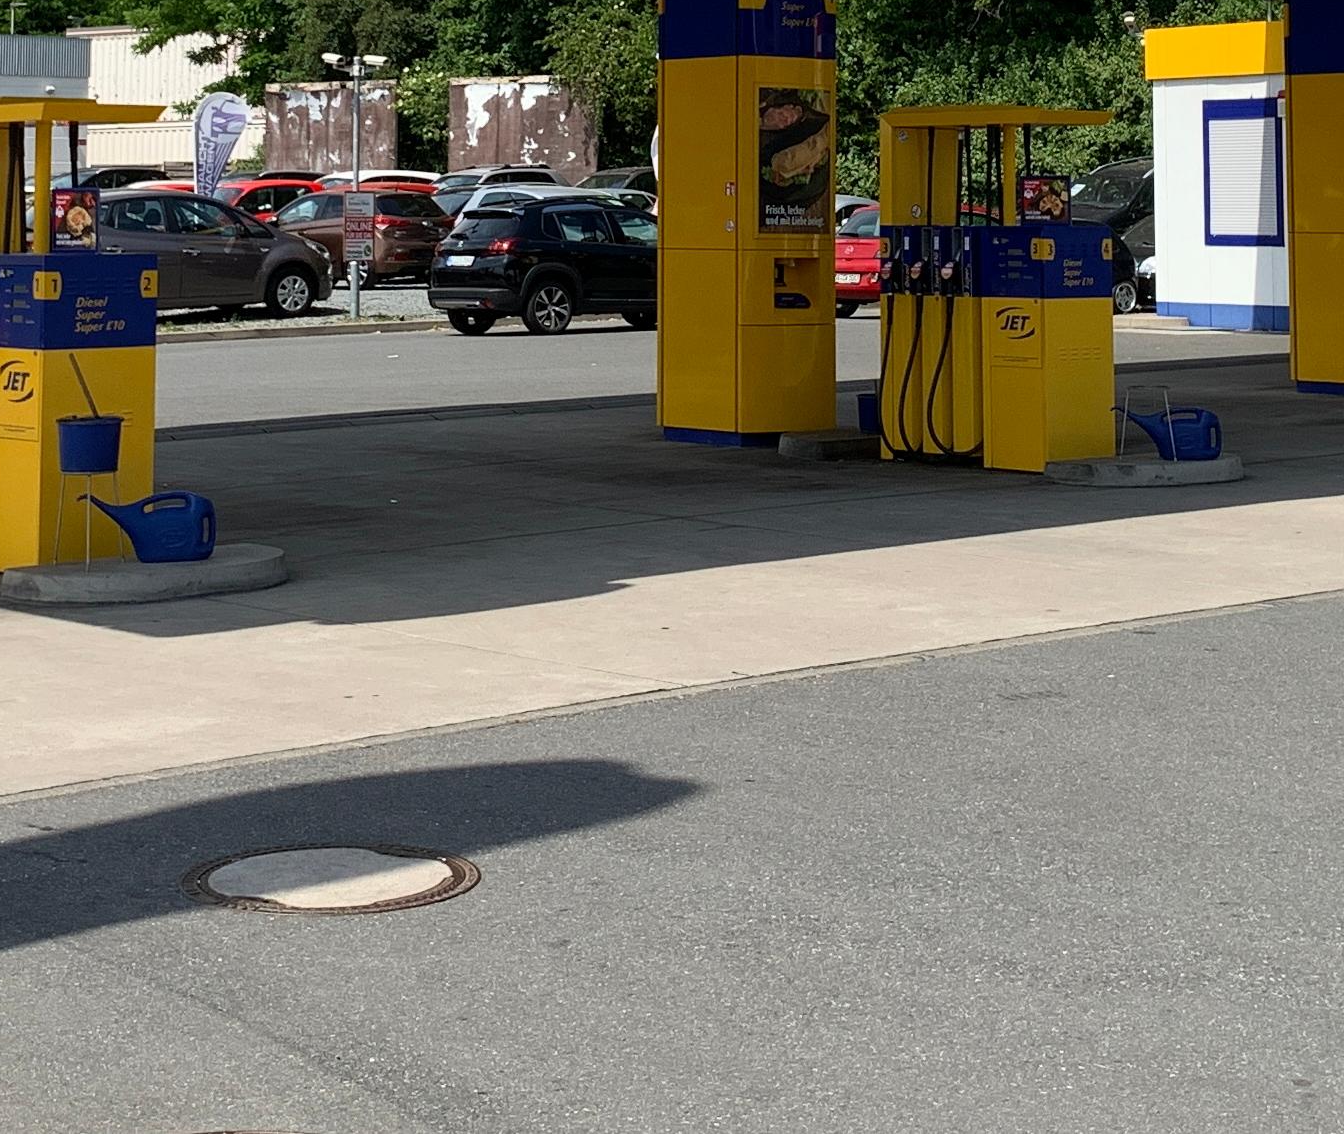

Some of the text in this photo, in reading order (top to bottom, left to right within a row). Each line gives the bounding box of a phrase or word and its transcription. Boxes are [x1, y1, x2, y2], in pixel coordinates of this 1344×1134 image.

[765, 204, 787, 216] Frisch,
[346, 221, 373, 232] ONLINE
[765, 216, 779, 226] und
[780, 216, 791, 226] mit
[143, 277, 152, 292] 2
[75, 296, 108, 308] Diesel
[75, 309, 106, 322] Super
[74, 320, 126, 335] Super E10
[1000, 315, 1030, 331] JET
[3, 370, 31, 392] JET
